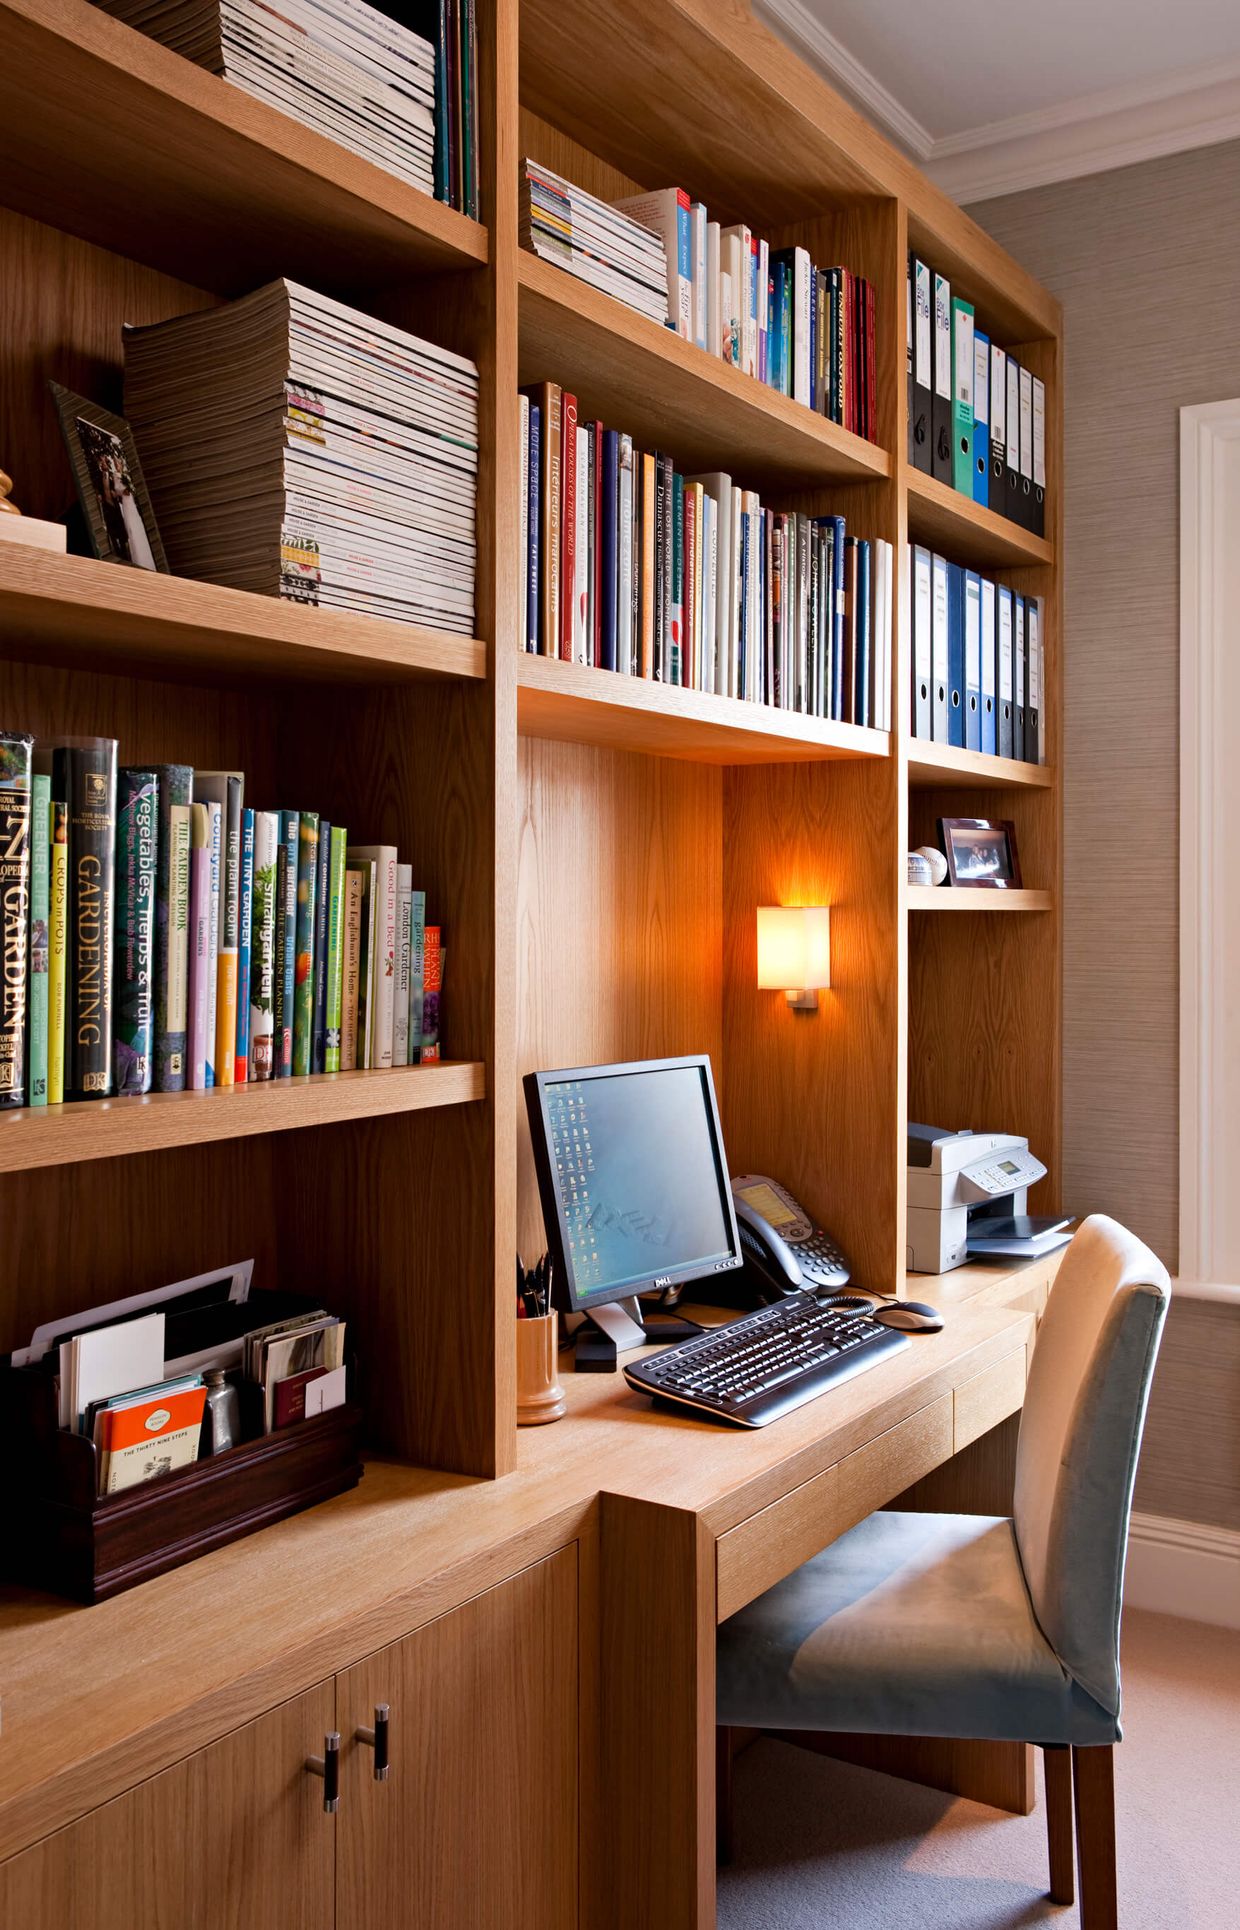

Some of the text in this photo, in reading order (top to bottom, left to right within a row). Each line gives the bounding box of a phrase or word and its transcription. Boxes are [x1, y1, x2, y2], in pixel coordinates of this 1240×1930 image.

[566, 405, 577, 447] OPERA
[551, 456, 560, 613] Intérieurs marocains
[35, 796, 46, 874] GREENER
[136, 791, 155, 903] vegetables,
[210, 813, 221, 893] Courtyard
[287, 821, 298, 840] the
[309, 841, 317, 863] Real
[34, 880, 46, 914] LIFE
[56, 857, 65, 904] CROPS
[177, 820, 189, 931] THE GARDEN BOOK
[227, 831, 238, 937] the plant room
[241, 827, 253, 947] THE TINY GARDEN
[286, 866, 297, 918] gardener
[387, 860, 396, 894] Good
[55, 920, 65, 955] POTS
[78, 855, 101, 1047] GARDENING
[138, 909, 150, 966] herbs
[331, 895, 339, 952] GARDENING
[347, 891, 358, 996] An Englishman's Home
[386, 926, 394, 947] Bed
[401, 901, 411, 992] London Gardener
[414, 921, 423, 974] gardening
[4, 884, 29, 1028] GARDEN
[277, 906, 286, 1028] THE GARDEN PLANNER
[284, 936, 295, 995] Urban Oasis
[655, 1277, 671, 1288] DELL
[136, 1442, 156, 1453] THIRTY
[157, 1437, 171, 1445] NINE
[171, 1431, 188, 1441] STEPS
